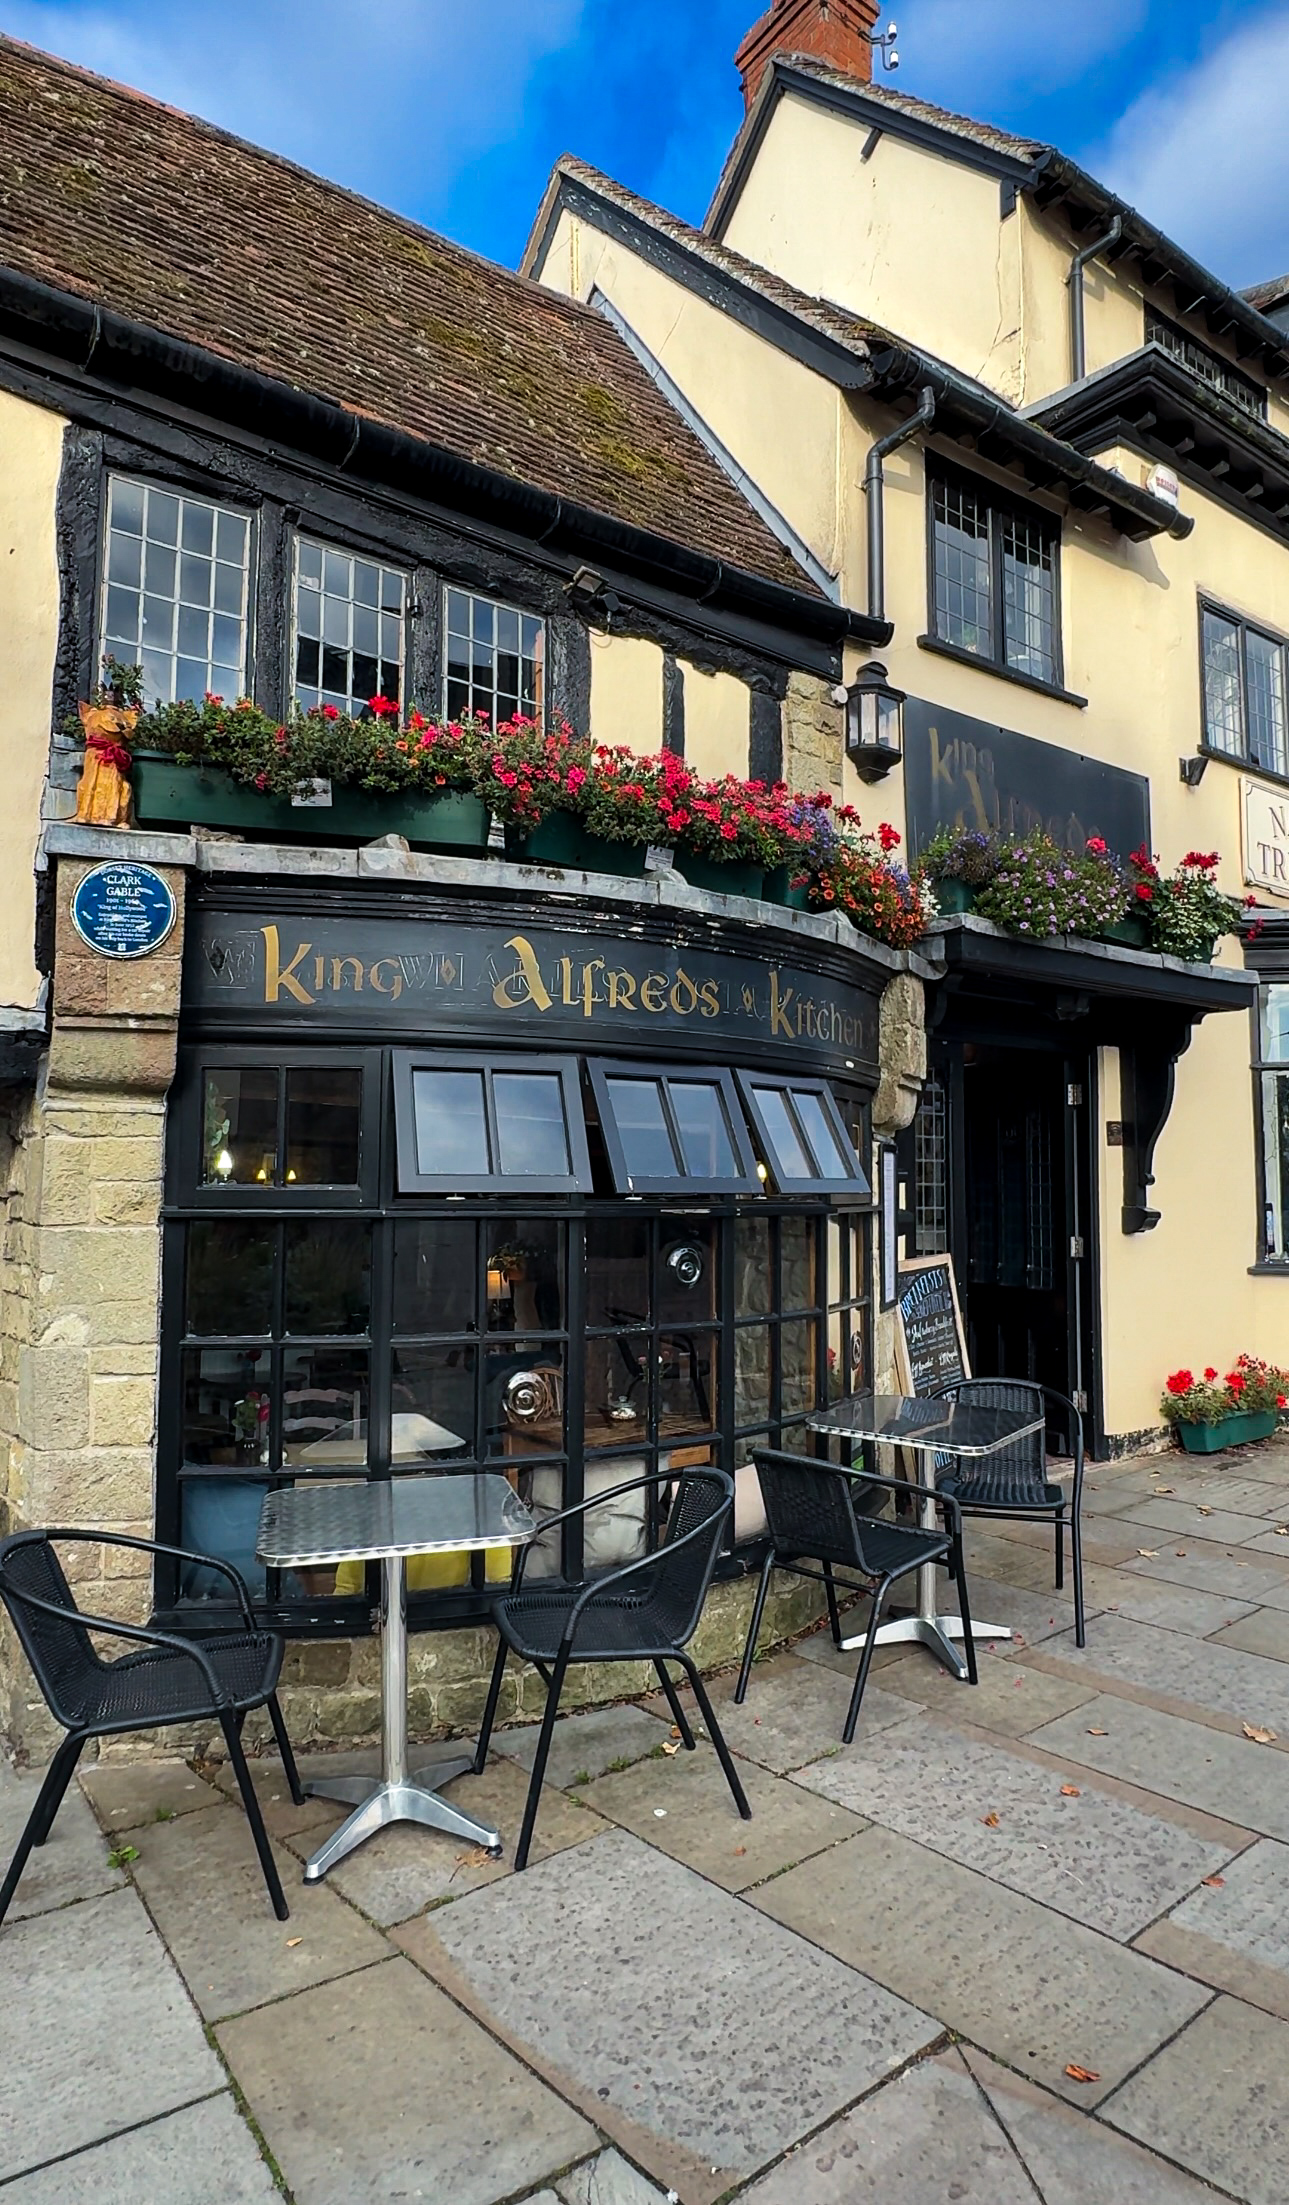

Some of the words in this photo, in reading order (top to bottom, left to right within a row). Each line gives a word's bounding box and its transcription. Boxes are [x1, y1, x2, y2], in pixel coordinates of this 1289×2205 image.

[1269, 805, 1289, 838] N
[1257, 841, 1289, 880] TR
[106, 887, 141, 896] GABLE
[107, 875, 142, 885] CLARK
[260, 925, 402, 1005] King
